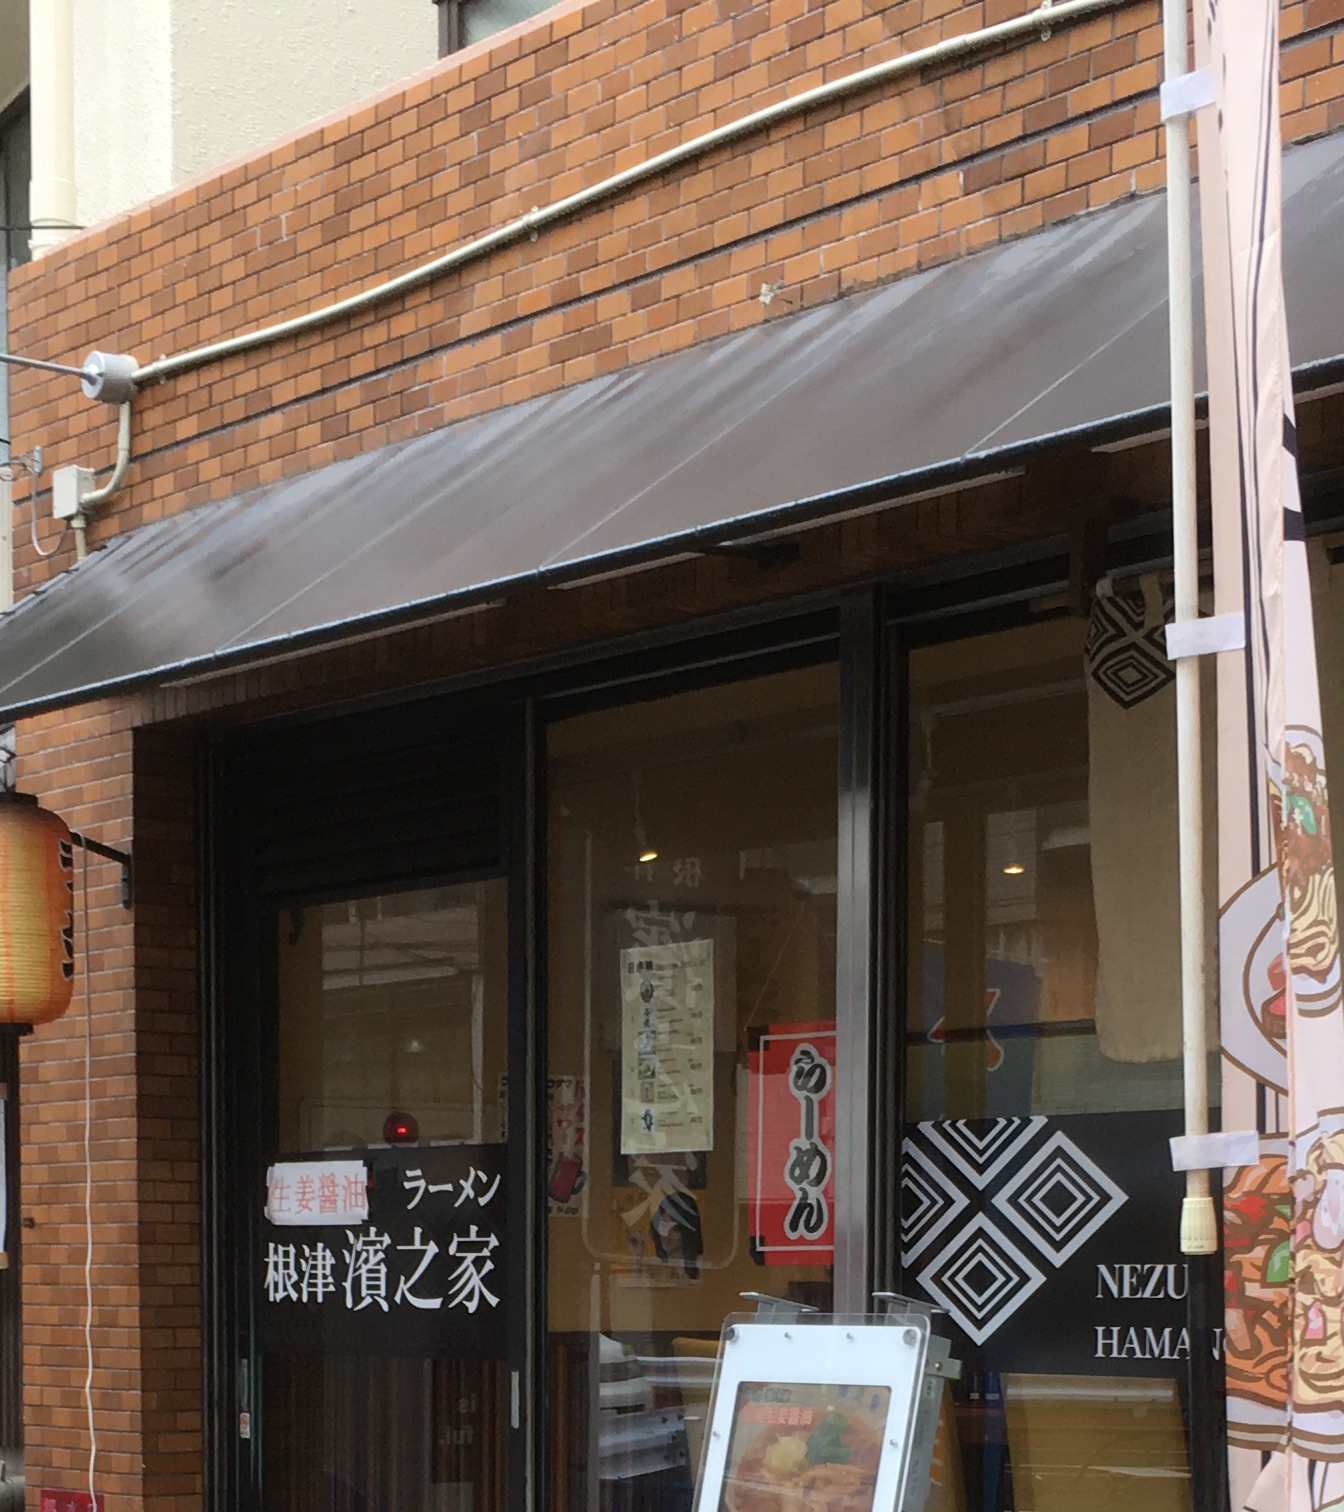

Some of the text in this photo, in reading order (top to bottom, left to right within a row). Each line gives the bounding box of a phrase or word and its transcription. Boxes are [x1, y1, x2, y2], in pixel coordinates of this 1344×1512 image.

[786, 1046, 831, 1238] らーめん
[402, 1166, 502, 1210] ラーメン
[1096, 1263, 1189, 1300] NEZU
[1093, 1326, 1226, 1361] HAMA
